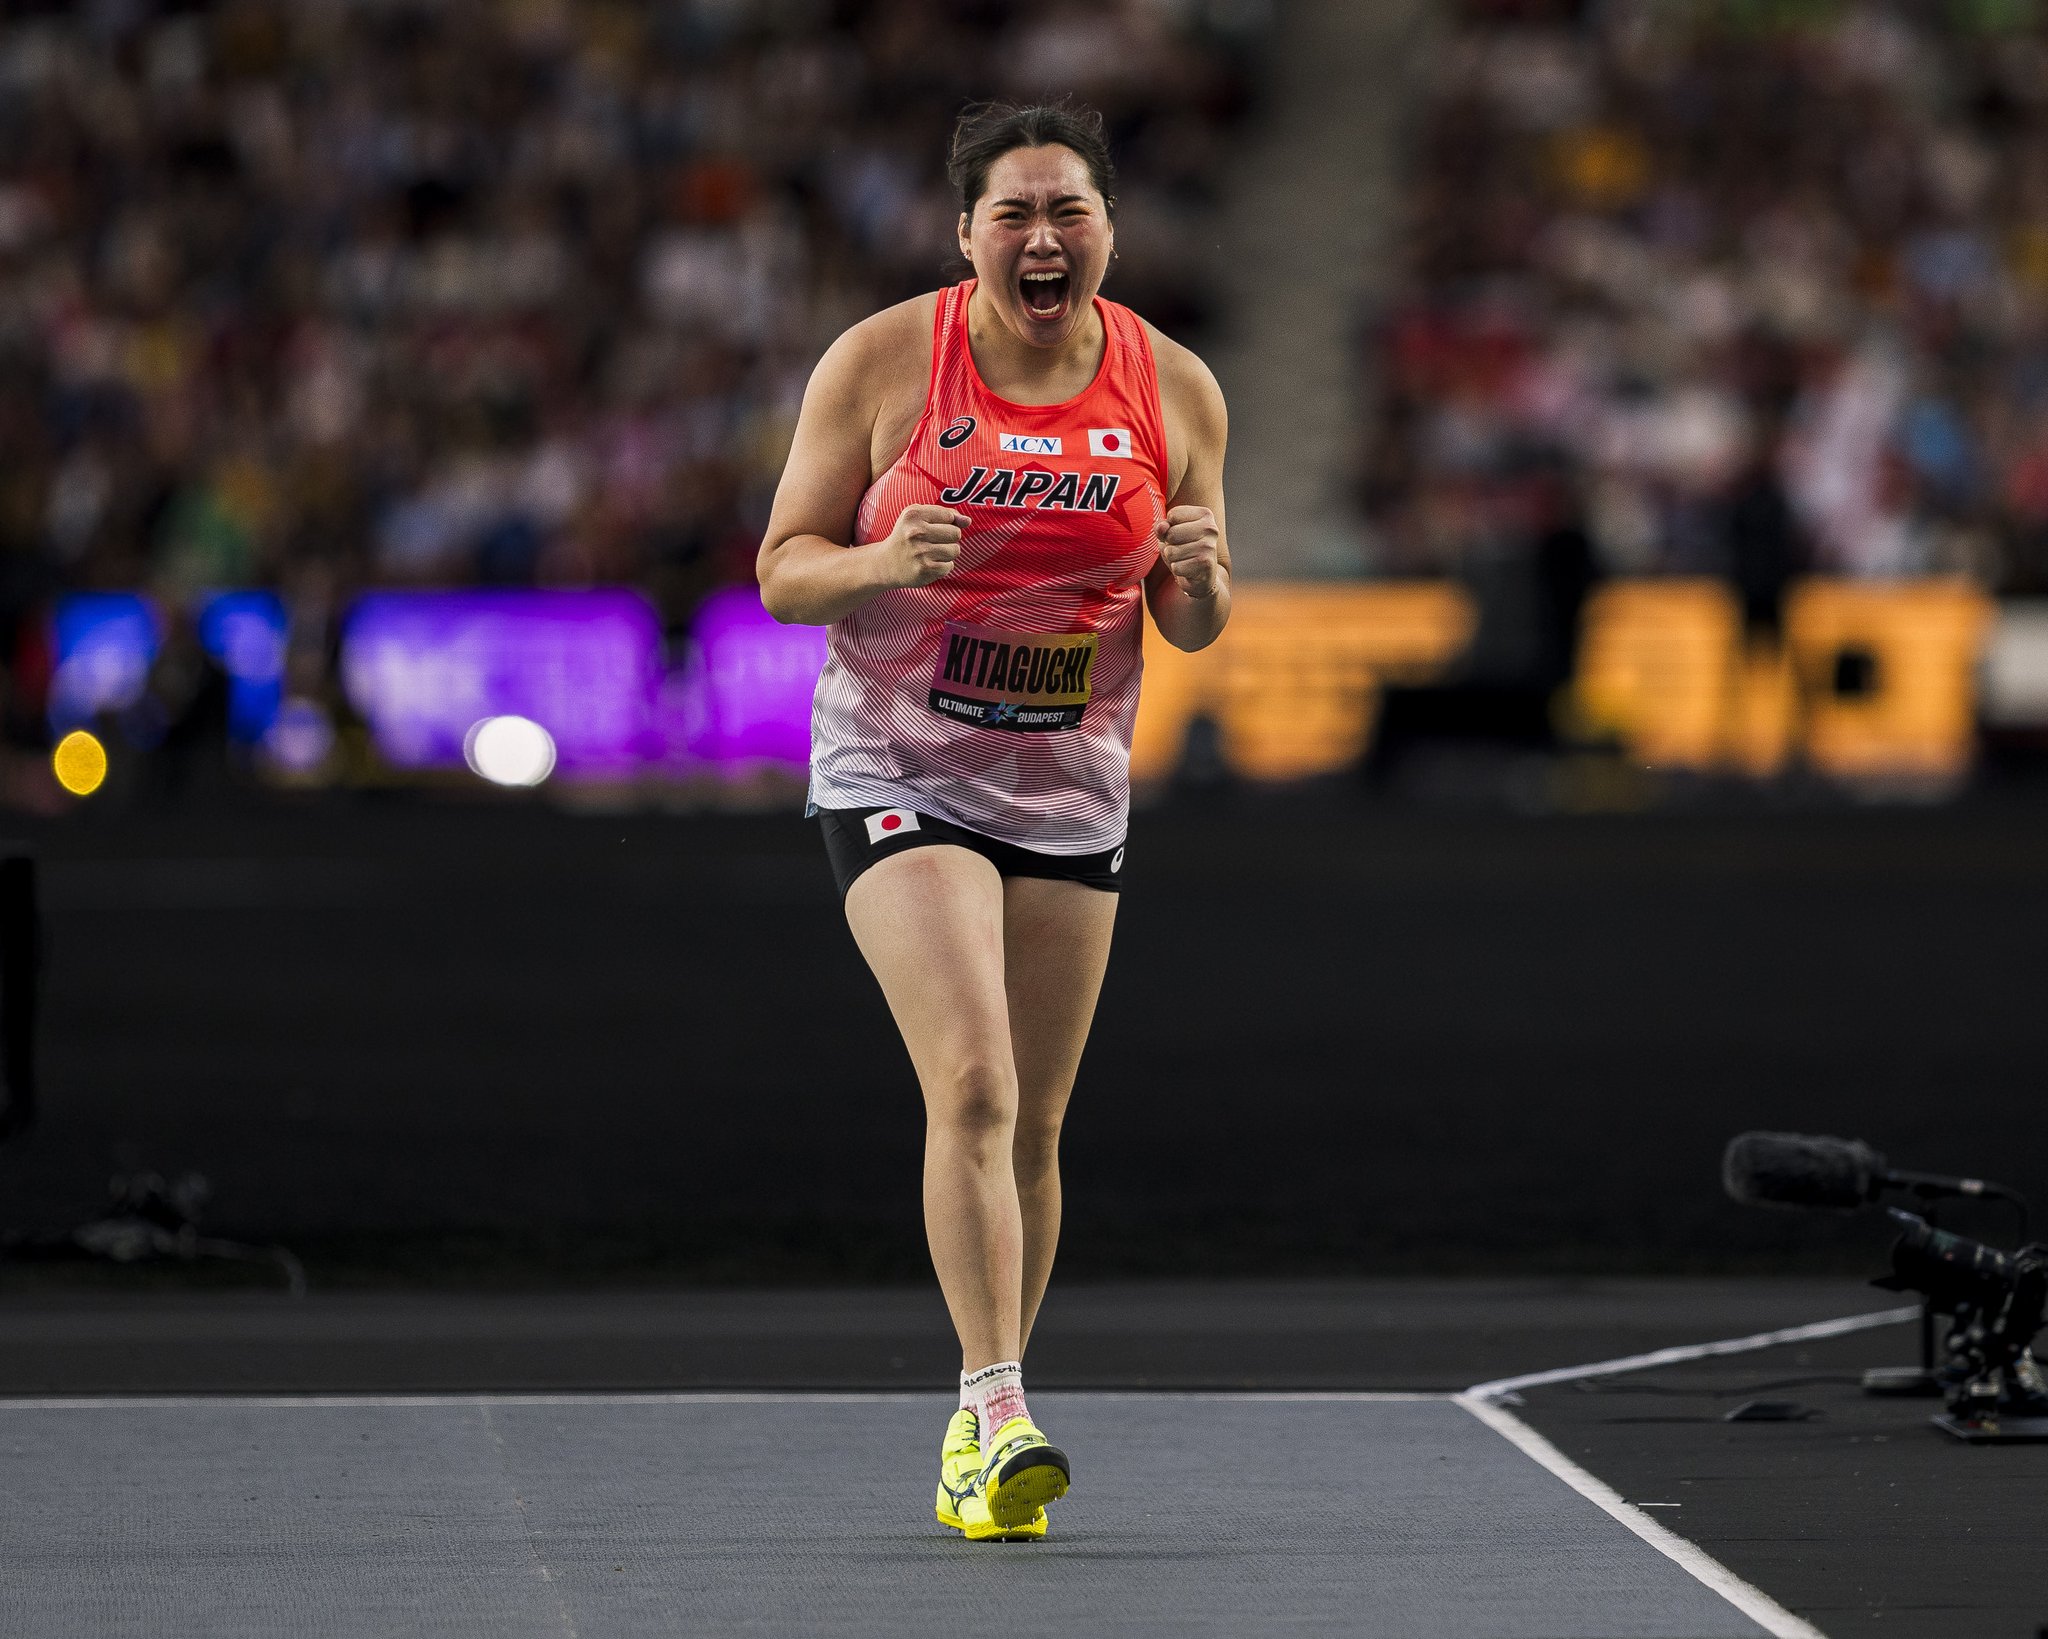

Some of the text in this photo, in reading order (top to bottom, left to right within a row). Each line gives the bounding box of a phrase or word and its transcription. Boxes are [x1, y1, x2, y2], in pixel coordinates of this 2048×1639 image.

[1004, 436, 1057, 453] ACN
[941, 466, 1120, 512] JAPAN
[944, 633, 1092, 694] KITAGUCHI
[938, 697, 985, 718] ULTIMATE
